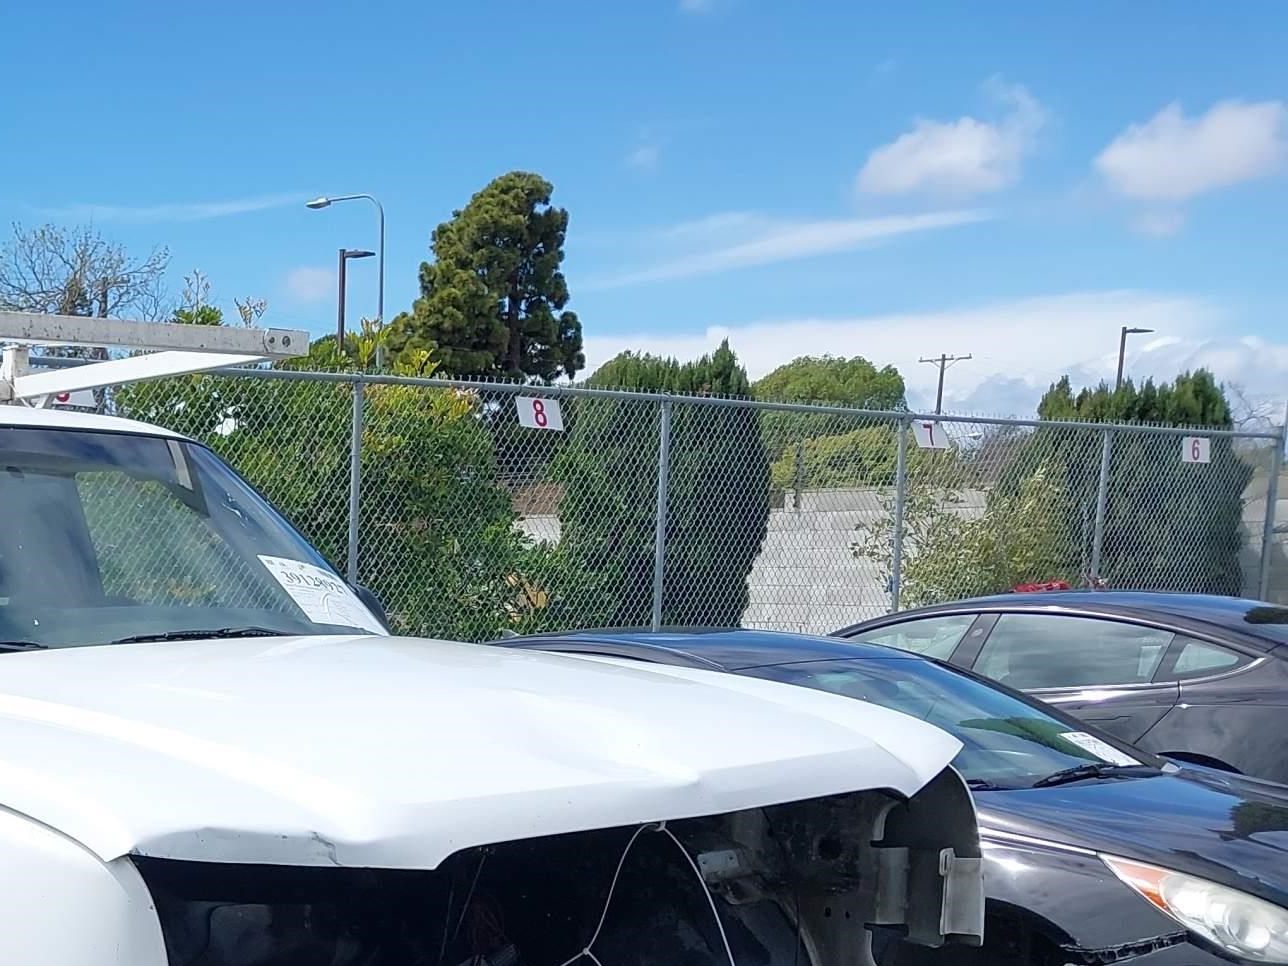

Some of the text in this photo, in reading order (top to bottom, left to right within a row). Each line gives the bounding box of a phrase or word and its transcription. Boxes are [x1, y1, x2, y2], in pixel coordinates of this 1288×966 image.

[532, 399, 548, 428] 8
[922, 423, 935, 446] 7
[1191, 438, 1201, 461] 6
